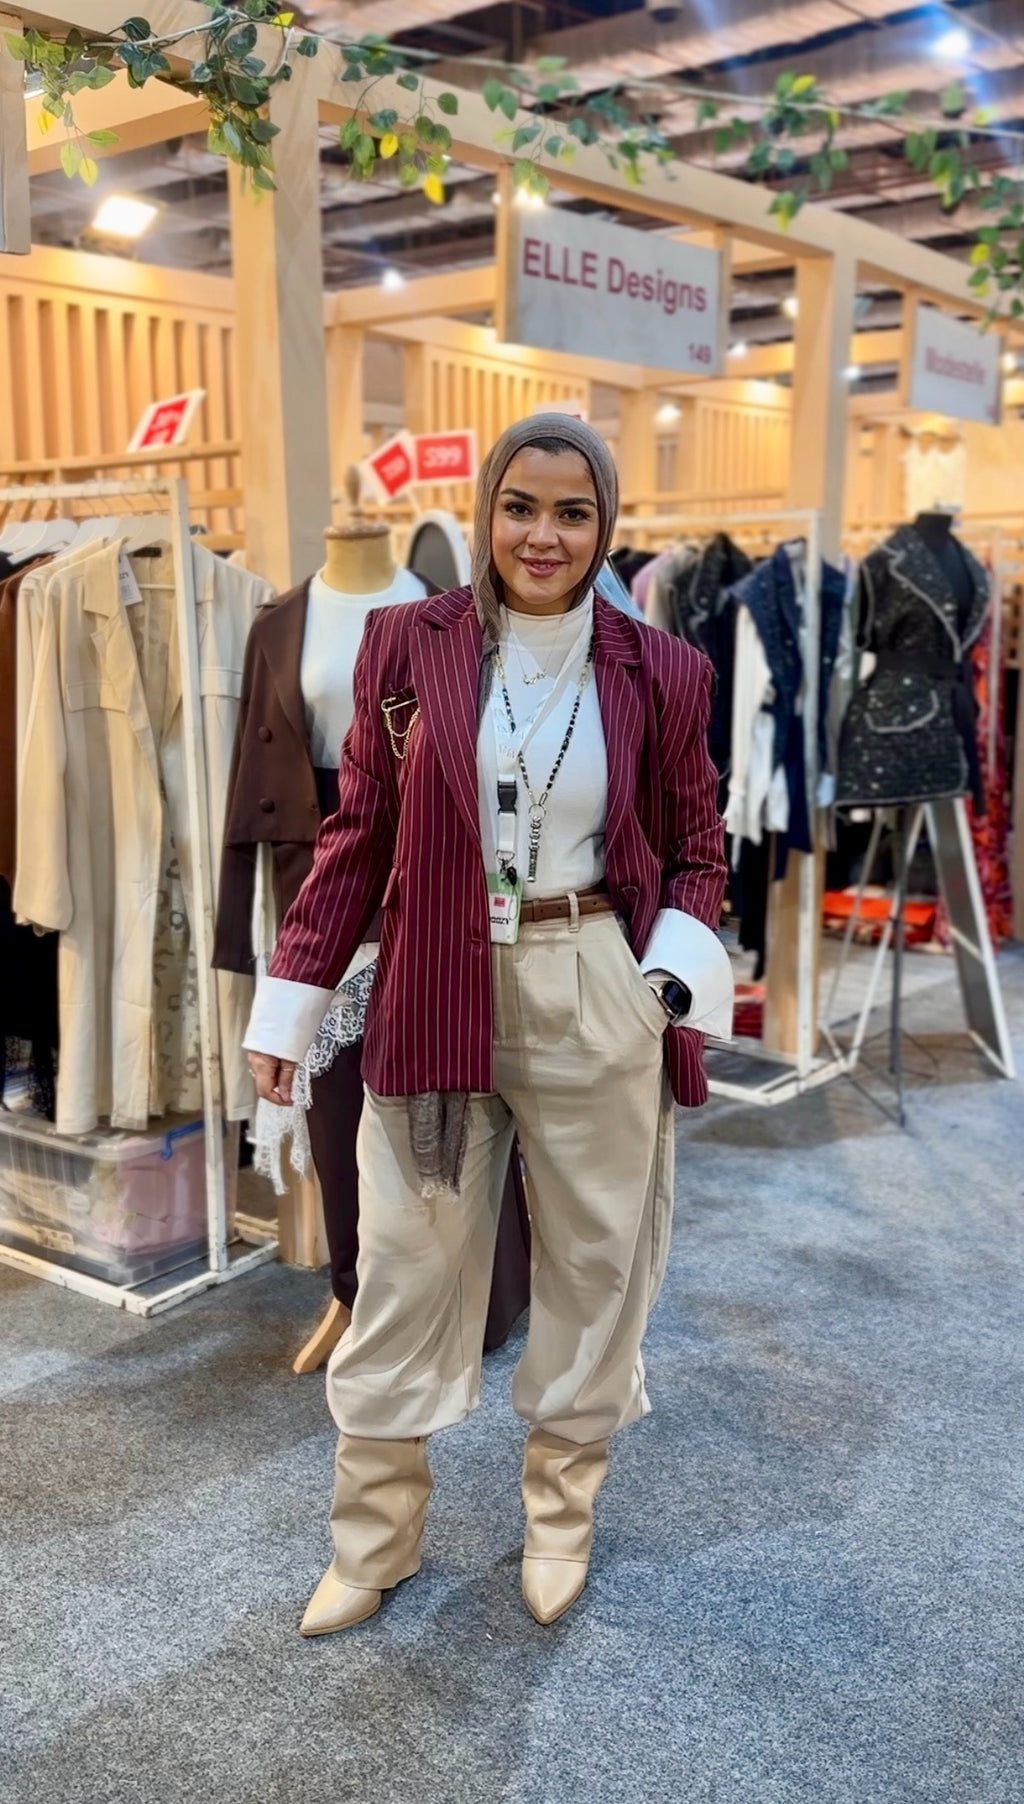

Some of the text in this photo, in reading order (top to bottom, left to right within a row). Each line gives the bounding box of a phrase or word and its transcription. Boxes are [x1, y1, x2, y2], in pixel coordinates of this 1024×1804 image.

[523, 238, 707, 314] ELLE Designs
[687, 343, 712, 364] 149
